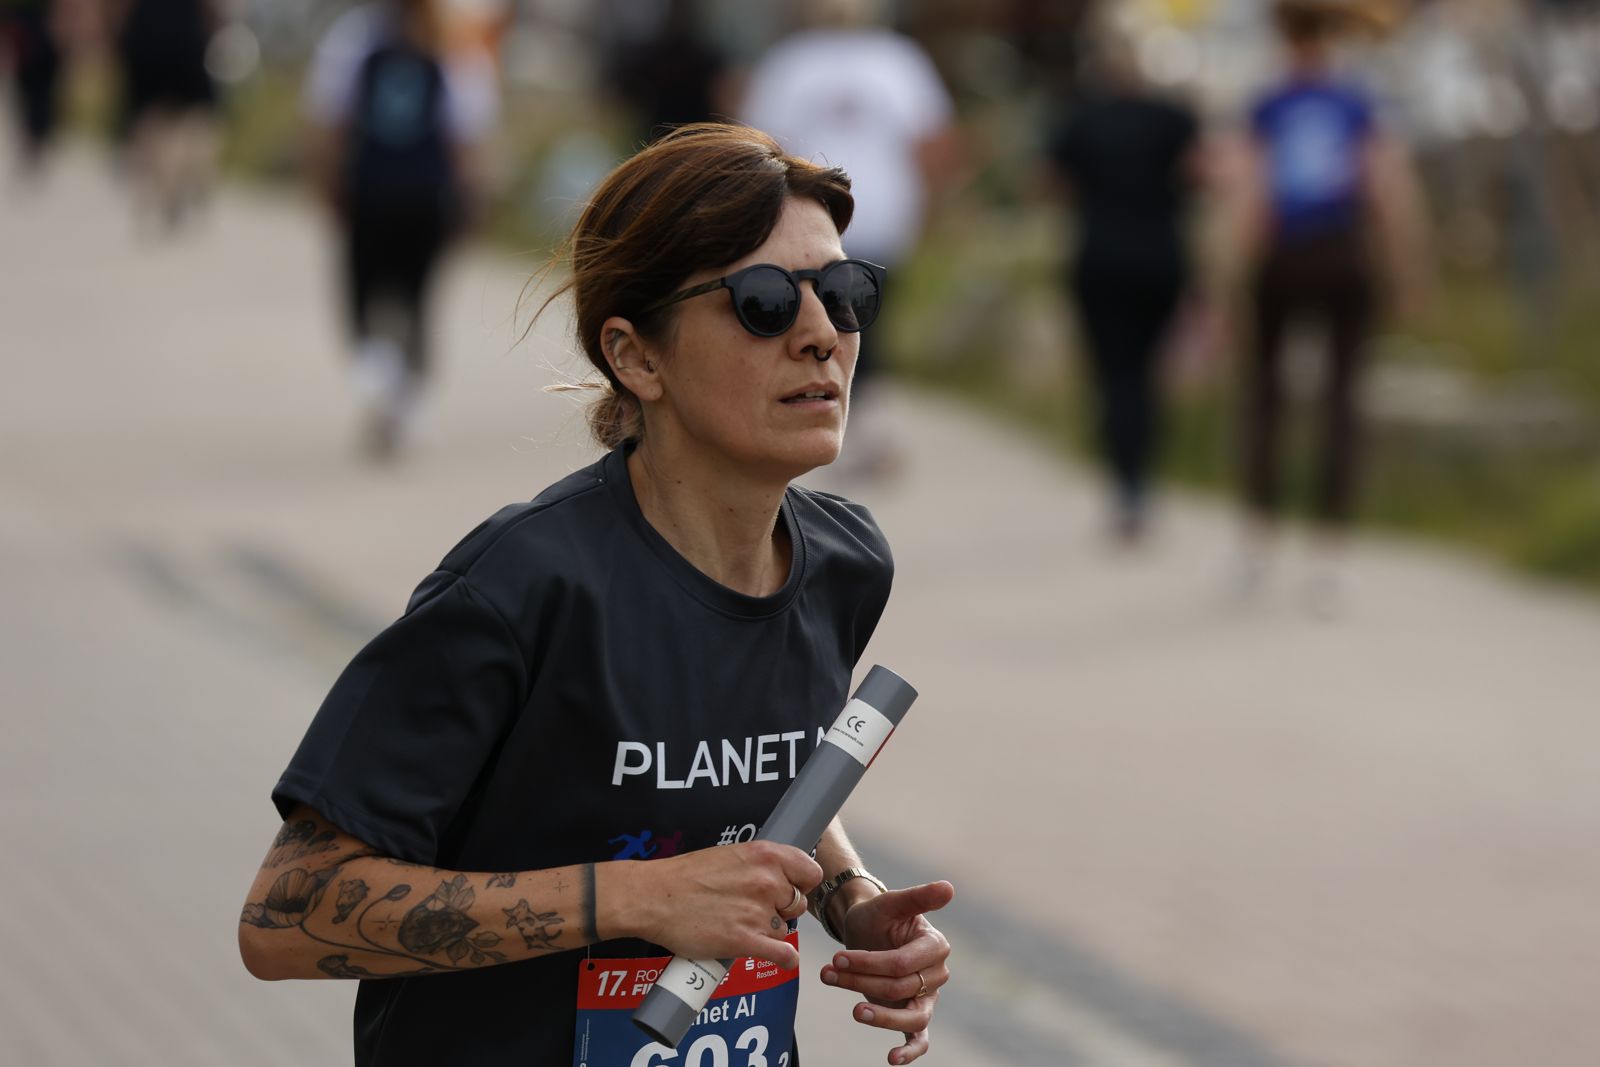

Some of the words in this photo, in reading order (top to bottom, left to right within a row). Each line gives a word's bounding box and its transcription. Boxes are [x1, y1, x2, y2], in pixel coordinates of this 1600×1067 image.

[846, 715, 866, 733] CE
[611, 730, 806, 789] PLANET
[716, 823, 762, 846] #O
[597, 970, 626, 996] 17.
[691, 1000, 730, 1026] net
